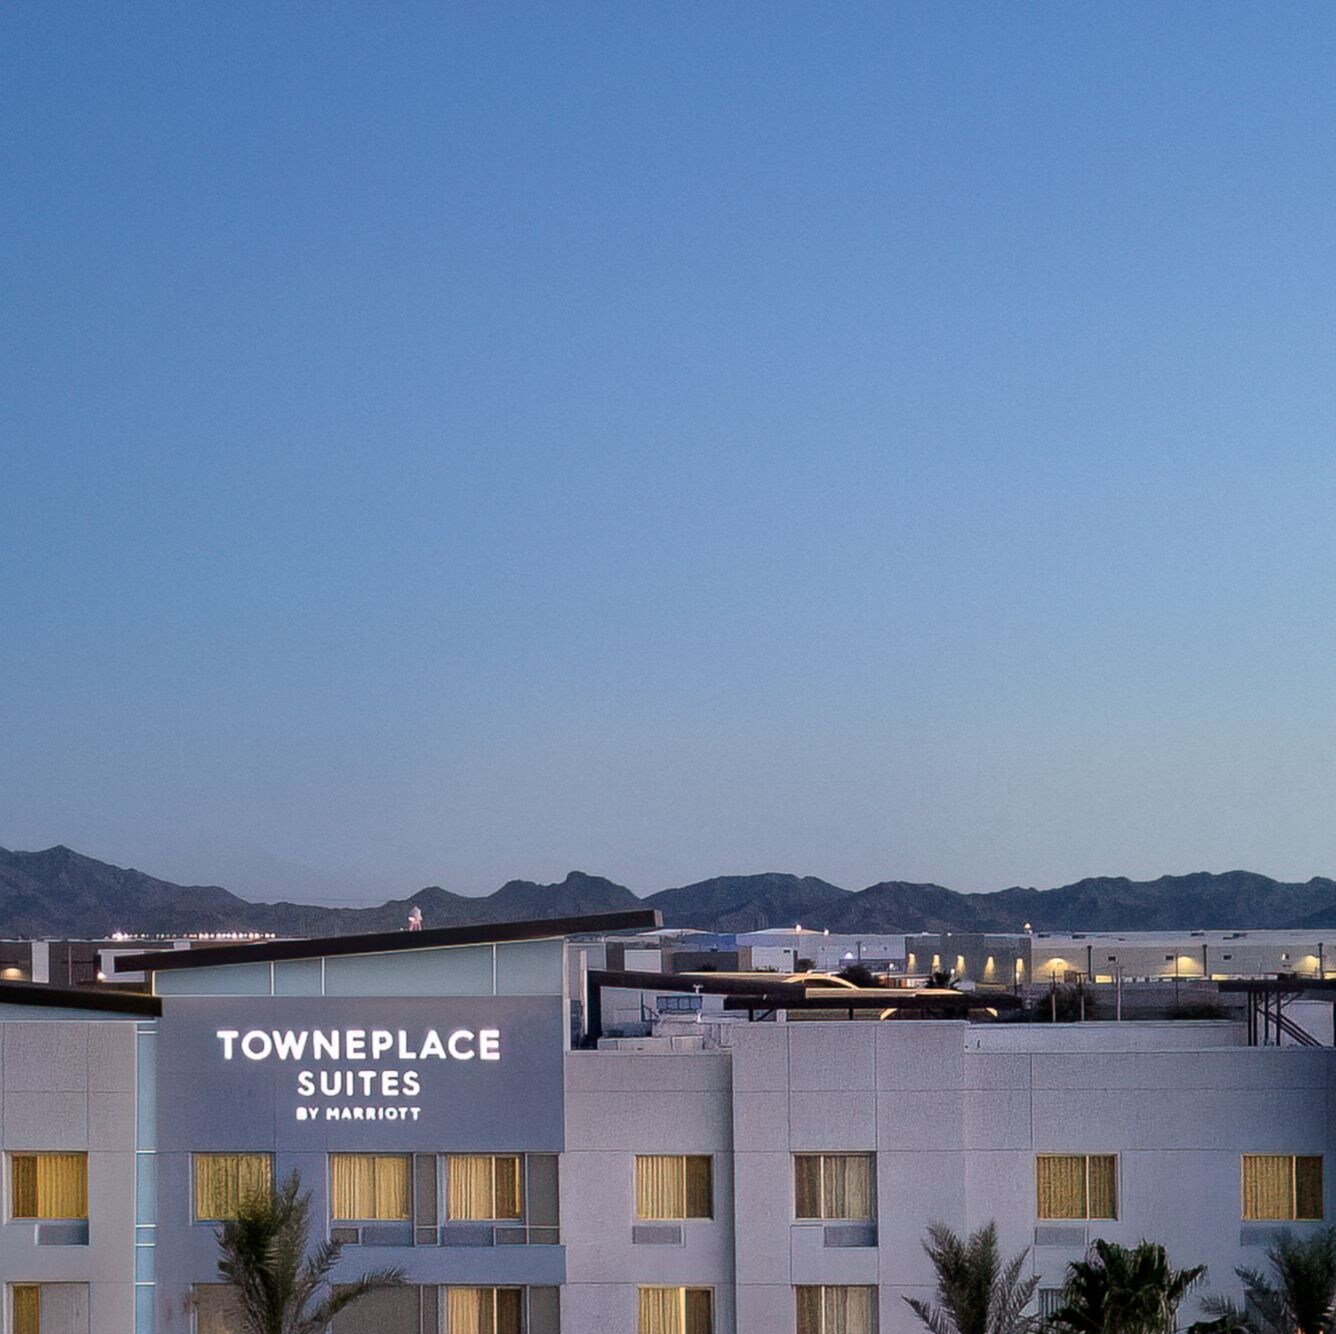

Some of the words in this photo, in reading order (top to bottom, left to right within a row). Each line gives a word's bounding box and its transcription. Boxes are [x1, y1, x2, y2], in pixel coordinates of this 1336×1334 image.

[216, 1029, 501, 1061] TOWNEPLACE
[297, 1070, 421, 1096] SUITES
[296, 1107, 319, 1120] BY
[326, 1107, 421, 1120] MARRIOTT
